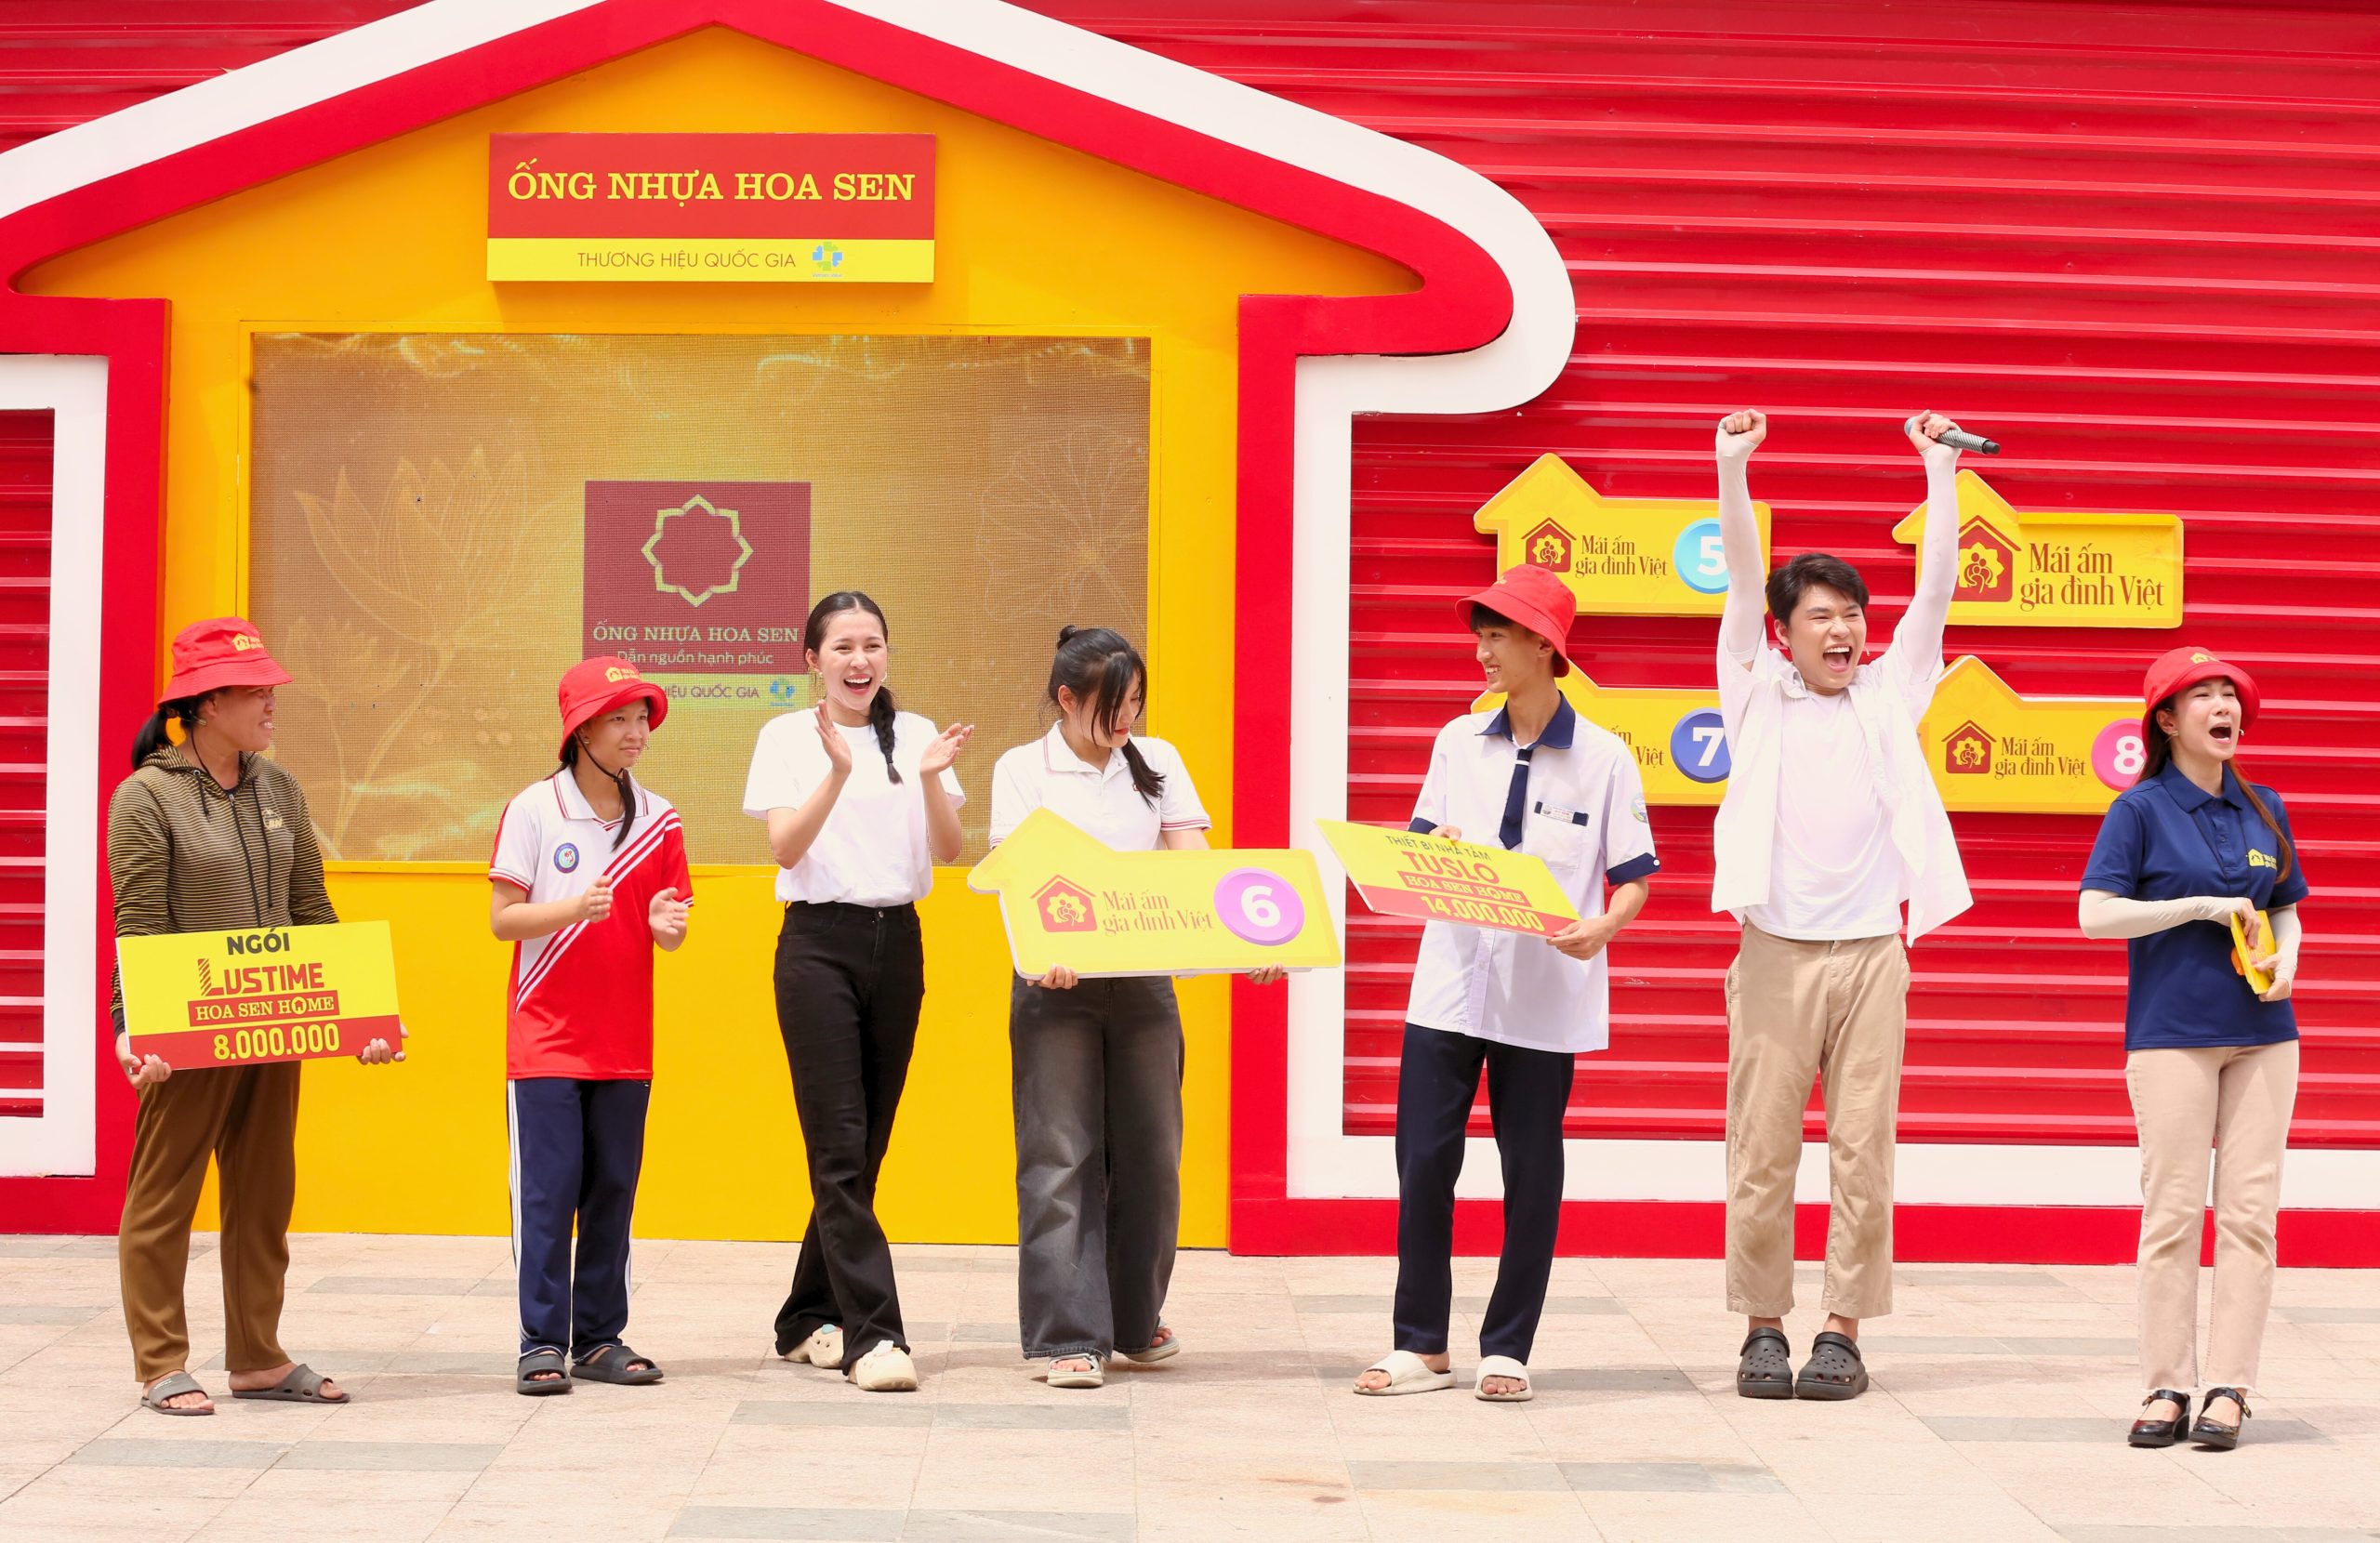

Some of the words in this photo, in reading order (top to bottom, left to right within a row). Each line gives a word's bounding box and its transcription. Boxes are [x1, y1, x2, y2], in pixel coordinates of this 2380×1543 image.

[508, 157, 597, 200] ỐNG
[607, 169, 723, 207] NHỰA
[734, 173, 822, 200] HOA
[832, 173, 915, 201] SEN
[577, 250, 655, 268] THƯƠNG
[660, 249, 700, 270] HIỆU
[705, 248, 759, 269] QUỐC
[764, 253, 796, 269] GIA
[1581, 535, 1607, 554] Mái
[1612, 535, 1635, 555] ấm
[1698, 535, 1727, 575] 5
[2029, 543, 2070, 573] Mái
[2077, 543, 2113, 574] ấm
[1575, 557, 1597, 579] gia
[1601, 556, 1635, 574] đình
[1639, 557, 1668, 578] Việt
[2019, 577, 2054, 612] gia
[2061, 575, 2114, 605] đình
[2119, 576, 2164, 611] Việt
[593, 619, 638, 641] ỐNG
[645, 626, 702, 645] NHỰA
[707, 626, 751, 642] HOA
[757, 627, 799, 643] SEN
[698, 651, 734, 666] hạnh
[738, 652, 774, 666] phúc
[664, 685, 687, 698] IỆU
[691, 683, 732, 698] QUỐC
[736, 687, 760, 698] GIA
[1636, 746, 1664, 769] Việt
[1693, 727, 1725, 766] 7
[2002, 737, 2027, 756] Mái
[2031, 737, 2055, 756] ấm
[2113, 735, 2145, 774] 8
[1994, 758, 2016, 780] gia
[2020, 757, 2055, 775] đình
[2057, 758, 2086, 778] Việt
[1401, 851, 1500, 884] TUSLO
[1103, 890, 1136, 910] Mái
[1141, 889, 1169, 910] ấm
[1405, 875, 1442, 890] HOA
[1442, 880, 1474, 894] SEN
[1474, 886, 1525, 903] HOME
[1240, 885, 1281, 927] 6
[1421, 895, 1545, 931] 14.000.000
[1103, 914, 1130, 937] gia
[1177, 910, 1212, 932] Việt
[227, 928, 290, 955] NGÓI
[197, 958, 324, 996] LUSTIME
[195, 1004, 234, 1021] HOA
[238, 1001, 272, 1017] SEN
[278, 996, 334, 1014] HOME
[214, 1022, 340, 1060] 8.000.000
